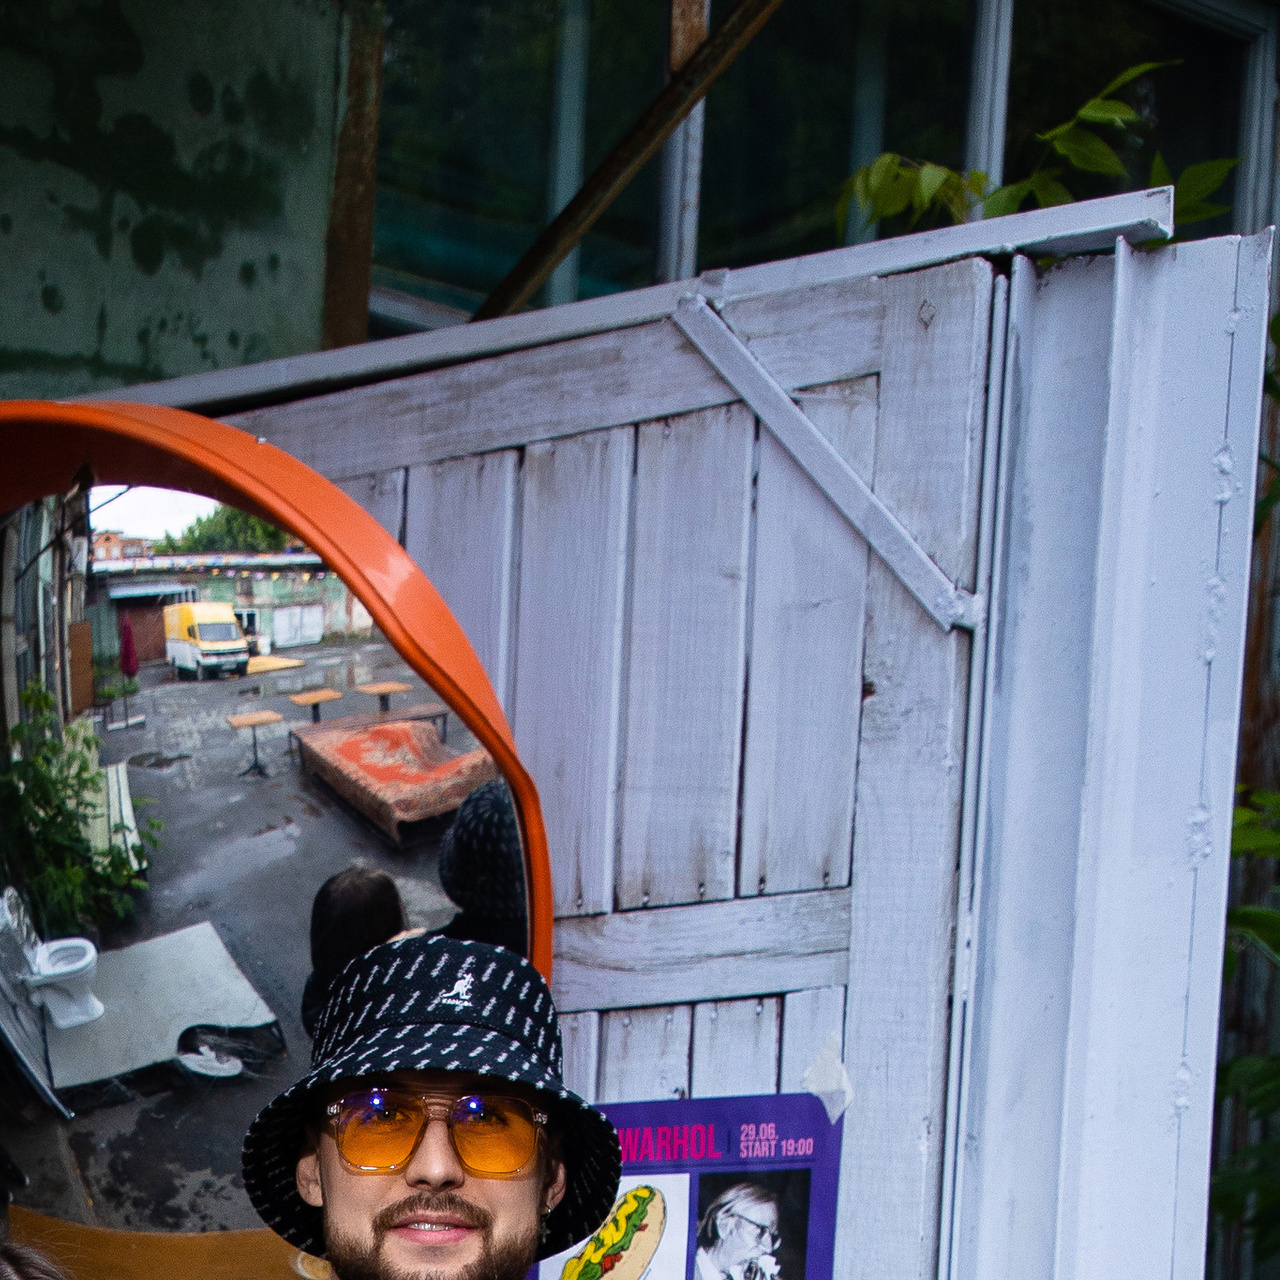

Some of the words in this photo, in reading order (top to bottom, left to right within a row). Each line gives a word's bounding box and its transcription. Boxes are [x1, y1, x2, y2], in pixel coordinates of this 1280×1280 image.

[619, 1124, 721, 1162] WARHOL
[740, 1140, 777, 1158] START
[781, 1138, 814, 1156] 19:00
